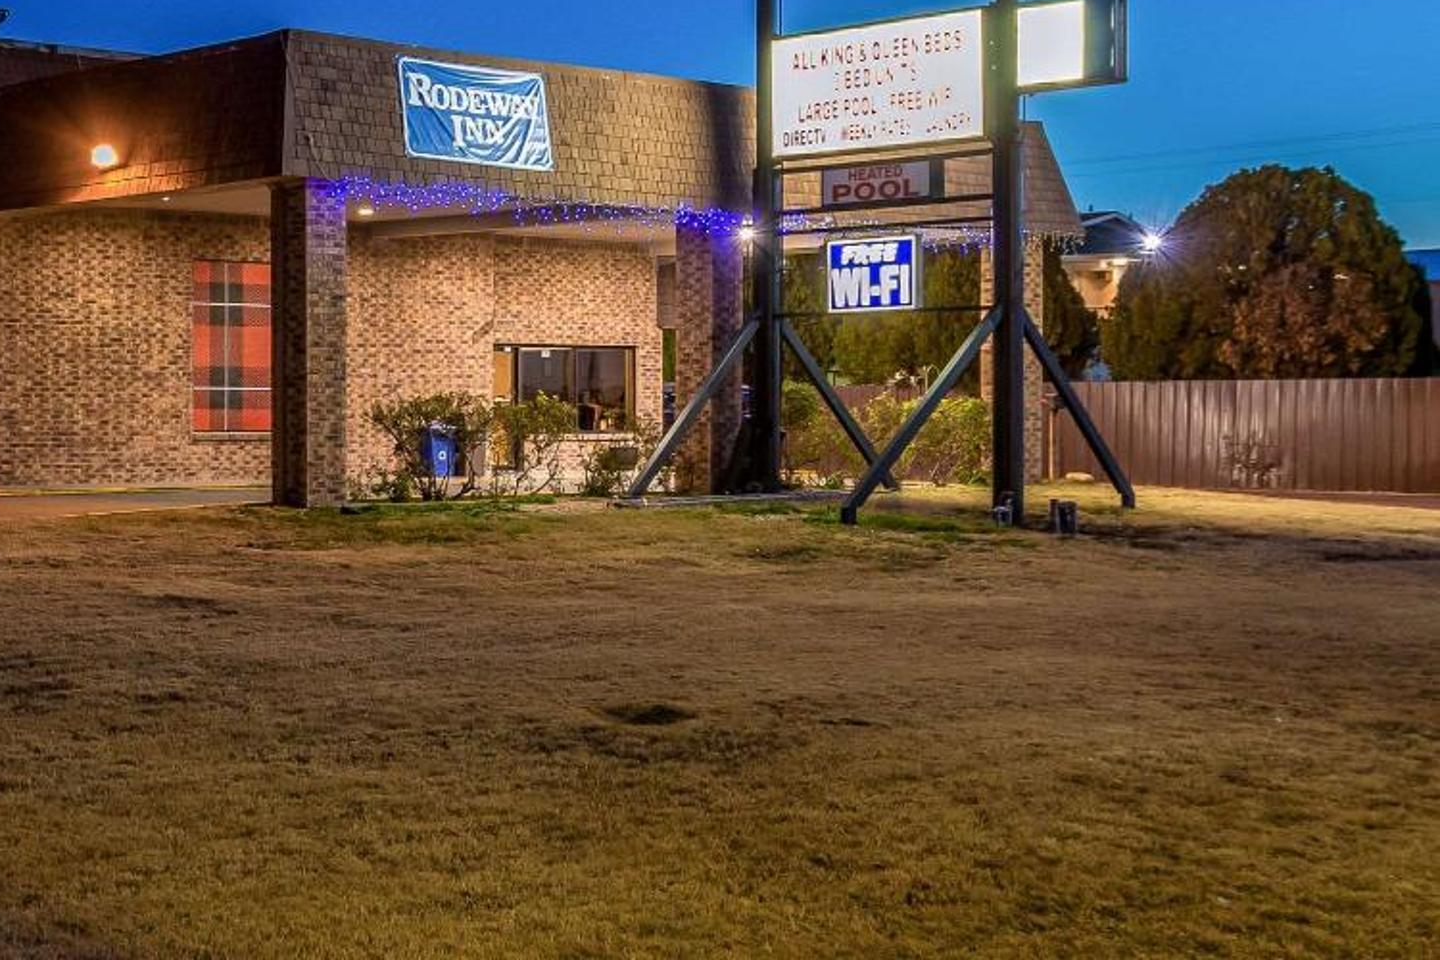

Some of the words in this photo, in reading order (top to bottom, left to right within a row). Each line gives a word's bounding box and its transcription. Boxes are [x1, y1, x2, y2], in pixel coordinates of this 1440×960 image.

[793, 49, 816, 70] ALL
[821, 45, 853, 66] KING
[924, 29, 961, 54] BEDS
[406, 71, 540, 119] RODEWAY
[798, 100, 838, 123] LARGE
[843, 96, 877, 118] POOL
[451, 115, 504, 149] INN
[848, 165, 903, 181] HEATED
[832, 179, 921, 202] POOL
[831, 264, 910, 307] WI-FI
